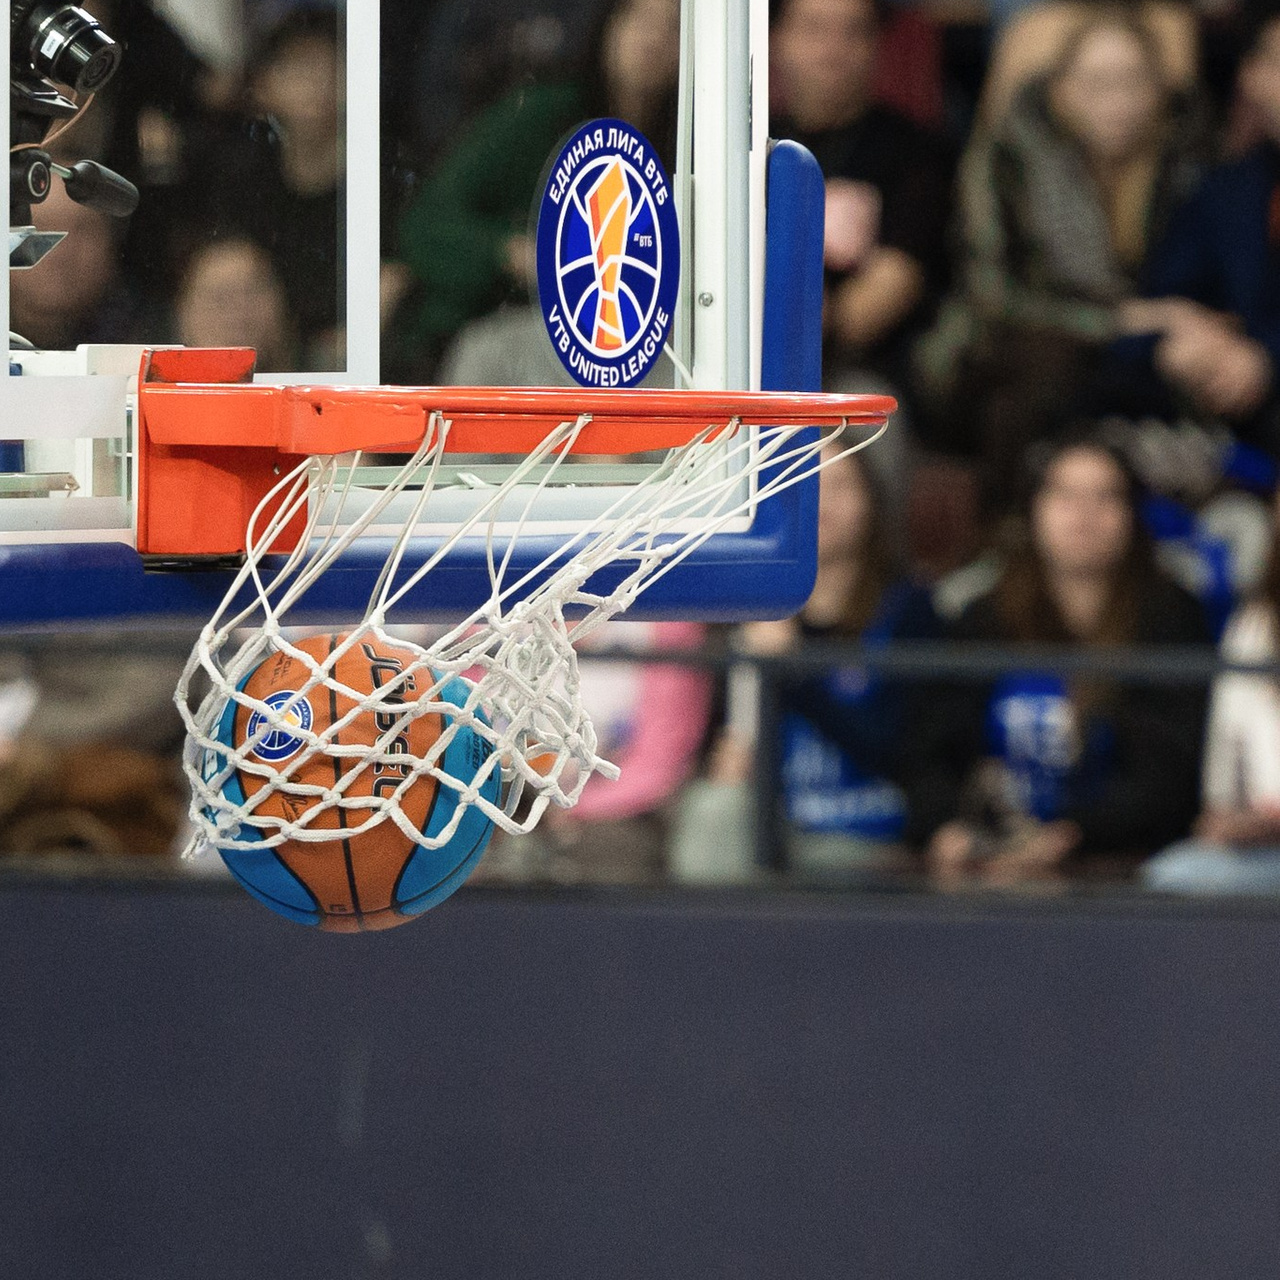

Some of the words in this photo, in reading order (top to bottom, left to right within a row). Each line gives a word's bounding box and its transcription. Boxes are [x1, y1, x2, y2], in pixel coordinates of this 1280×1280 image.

[549, 128, 604, 206] ЕДИНАЯ
[606, 127, 644, 167] ЛИГА
[644, 153, 669, 207] ВТБ
[548, 304, 571, 354] VTB
[568, 350, 621, 387] UNITED
[620, 305, 669, 385] LEAGUE
